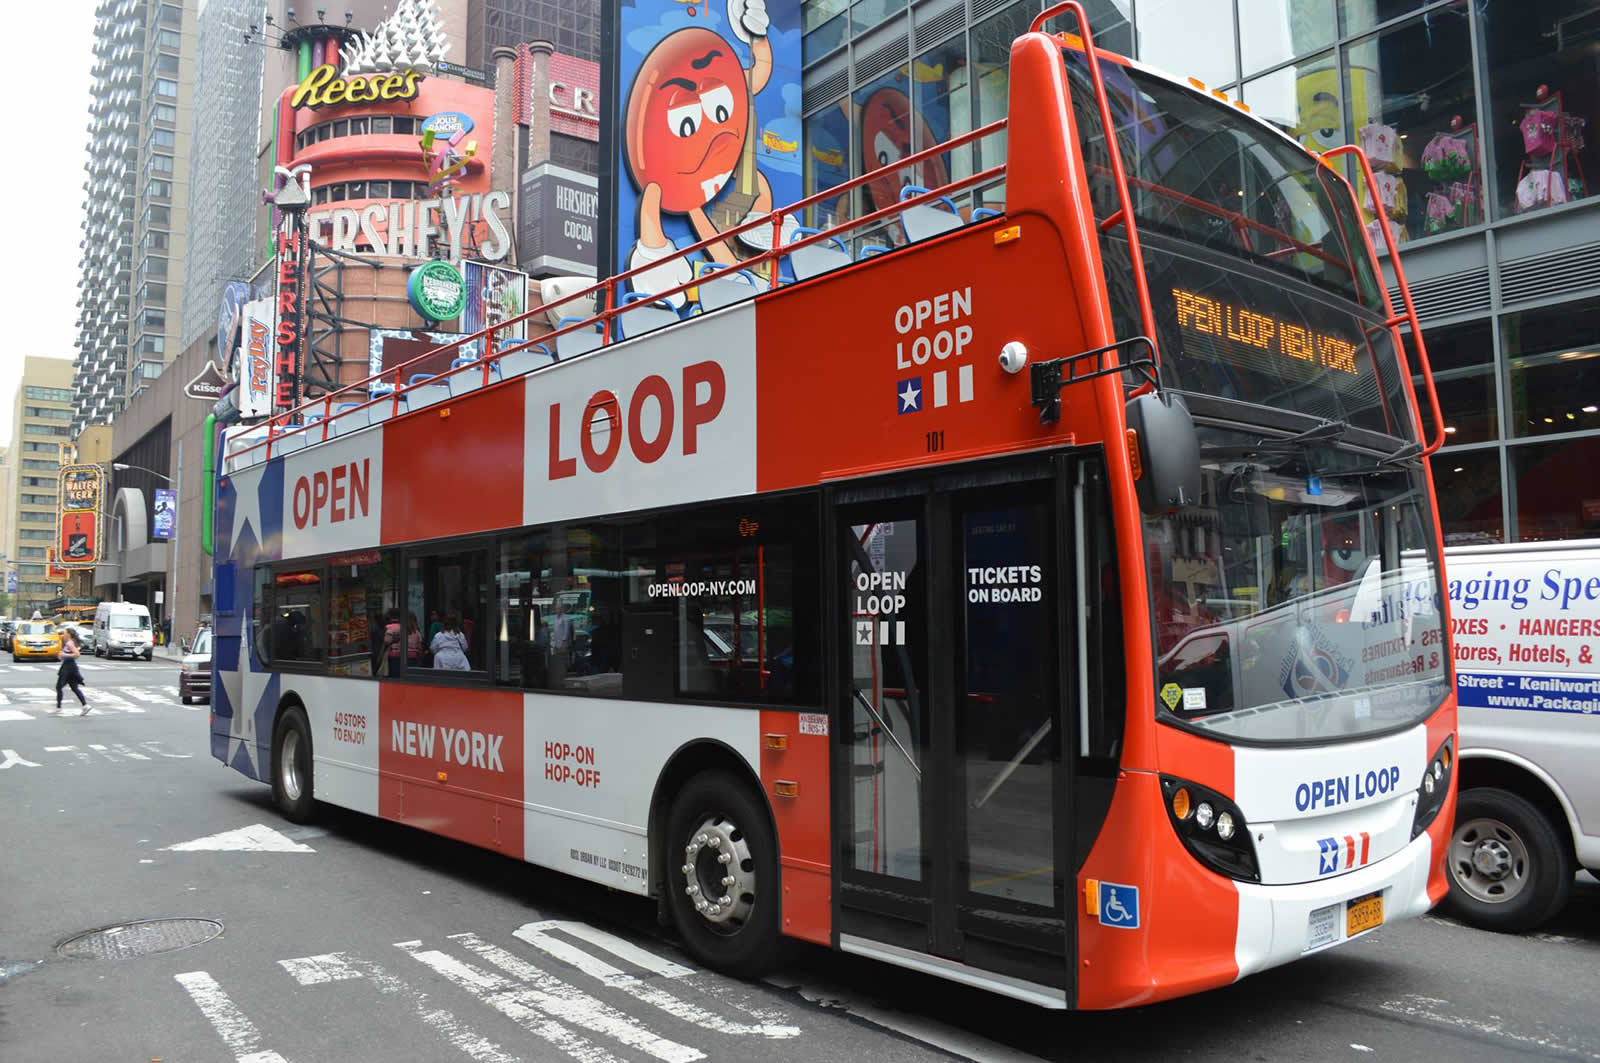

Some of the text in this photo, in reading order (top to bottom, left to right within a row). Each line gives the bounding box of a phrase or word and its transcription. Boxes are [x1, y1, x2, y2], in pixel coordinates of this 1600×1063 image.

[290, 64, 421, 108] Reese's
[436, 115, 457, 125] JOLLY
[564, 220, 593, 244] COCOA
[894, 286, 973, 335] OPEN
[896, 324, 974, 371] LOOP
[1226, 304, 1276, 350] LOOP
[1316, 333, 1359, 376] YORK
[249, 318, 270, 394] PayDay
[548, 360, 727, 481] LOOP
[926, 430, 946, 453] 101
[66, 481, 98, 491] WALTER
[292, 457, 371, 531] OPEN
[856, 570, 906, 592] OPEN
[968, 564, 1043, 585] TICKETS
[648, 579, 757, 598] OPENLOOP-NY.COM
[968, 586, 1043, 604] ON BOARD
[1541, 568, 1600, 611] Spe
[856, 594, 906, 615] LOOP
[1508, 643, 1571, 668] Hotels,
[1578, 644, 1593, 664] &
[1458, 674, 1504, 689] Street
[334, 711, 366, 729] 40 STOPS
[333, 726, 366, 745] TO ENJOY
[391, 719, 505, 773] NEW YORK
[545, 741, 595, 766] HOP-ON
[545, 763, 601, 789] HOP-OFF
[1294, 766, 1401, 813] OPEN LOOP
